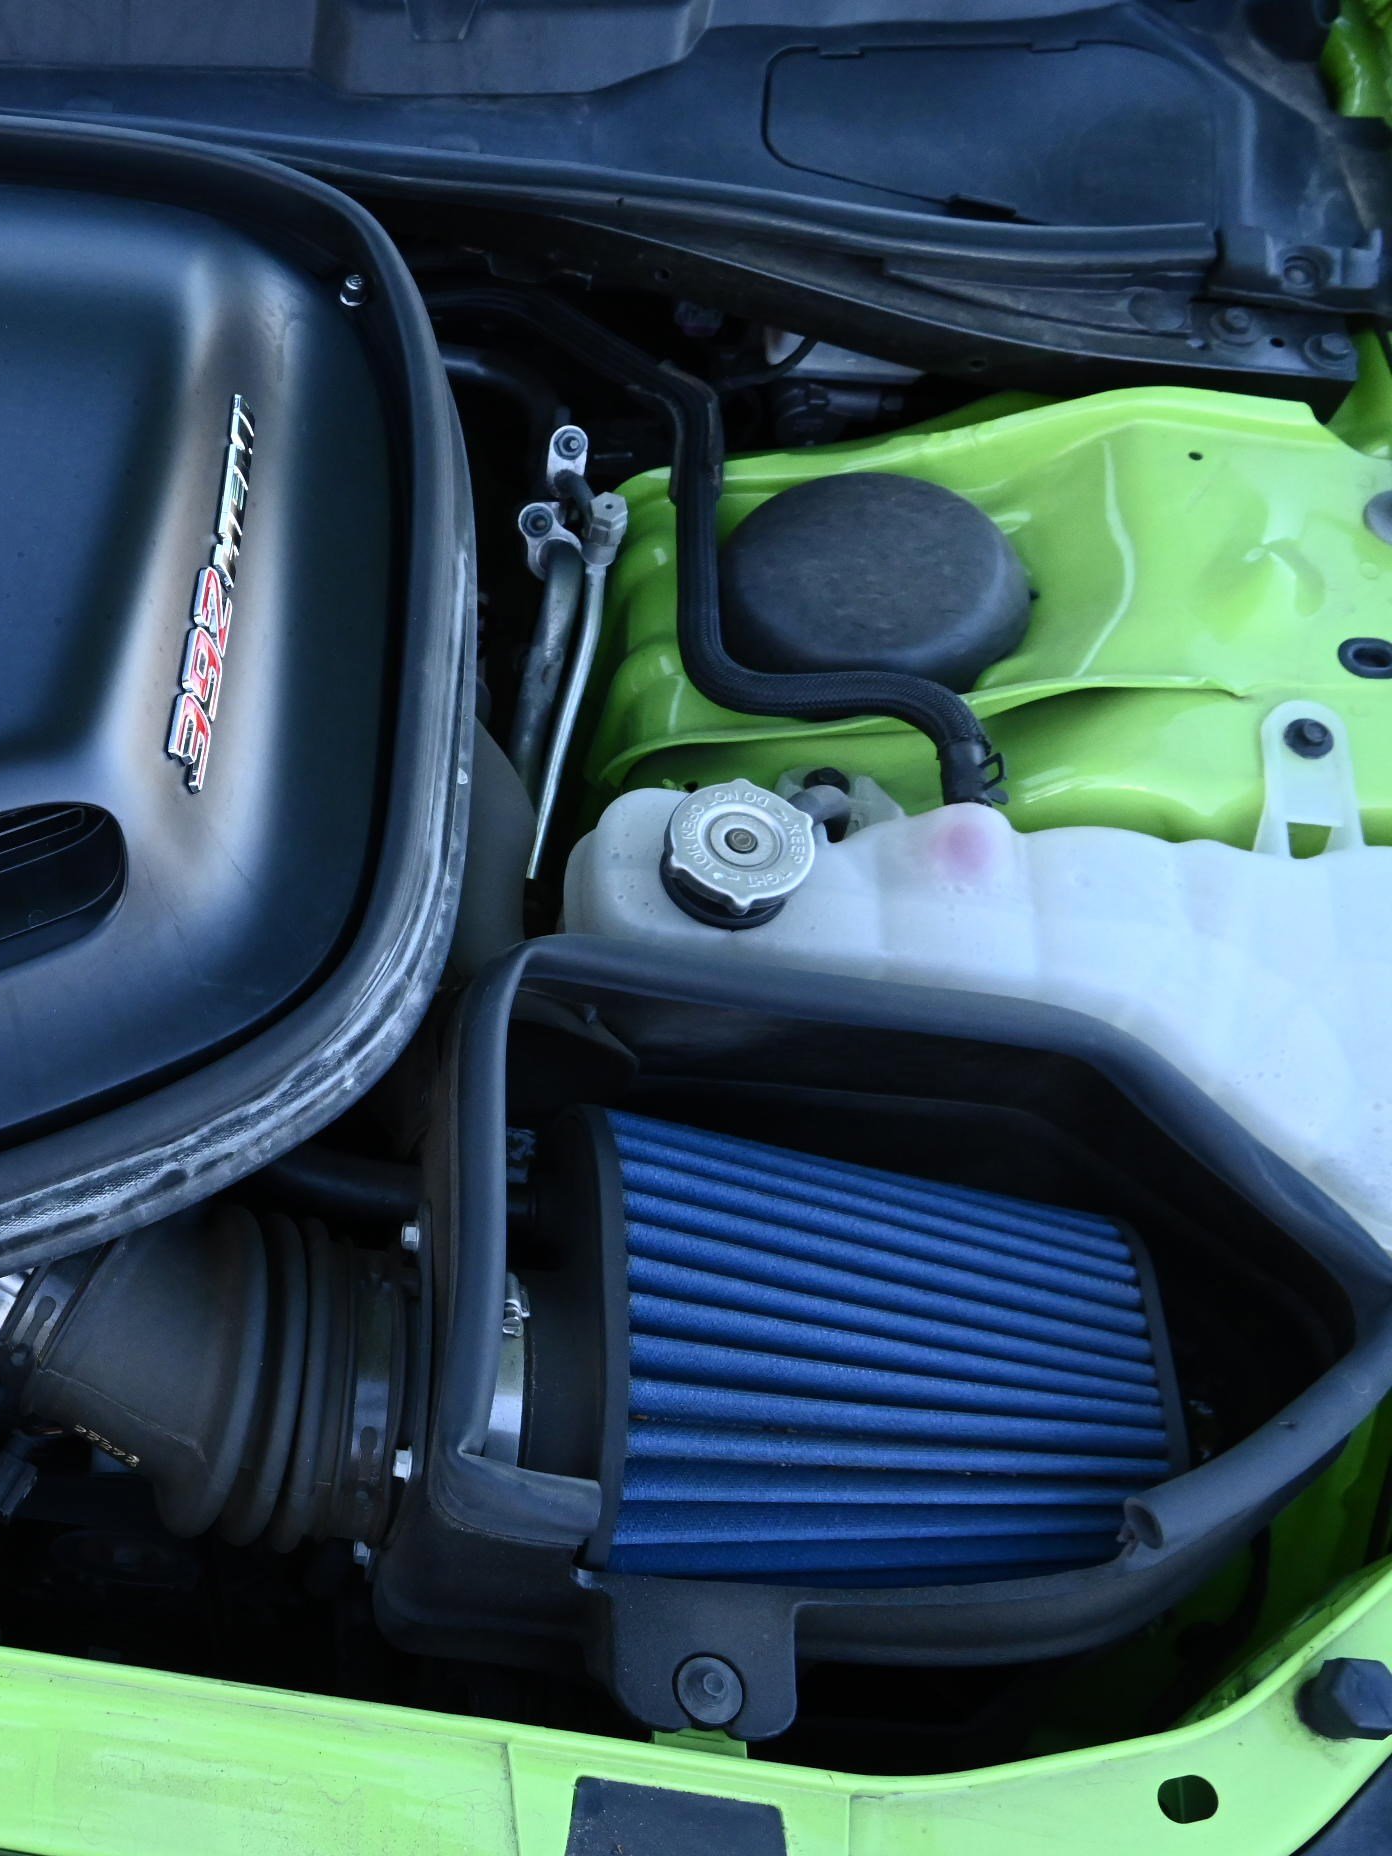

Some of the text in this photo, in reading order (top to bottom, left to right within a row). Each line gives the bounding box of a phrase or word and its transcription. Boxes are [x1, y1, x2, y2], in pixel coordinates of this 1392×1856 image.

[168, 566, 233, 793] 392
[709, 790, 739, 807] NOT
[743, 791, 770, 808] DO
[682, 804, 705, 840] OPEN
[747, 823, 806, 888] KEEP TIGHT
